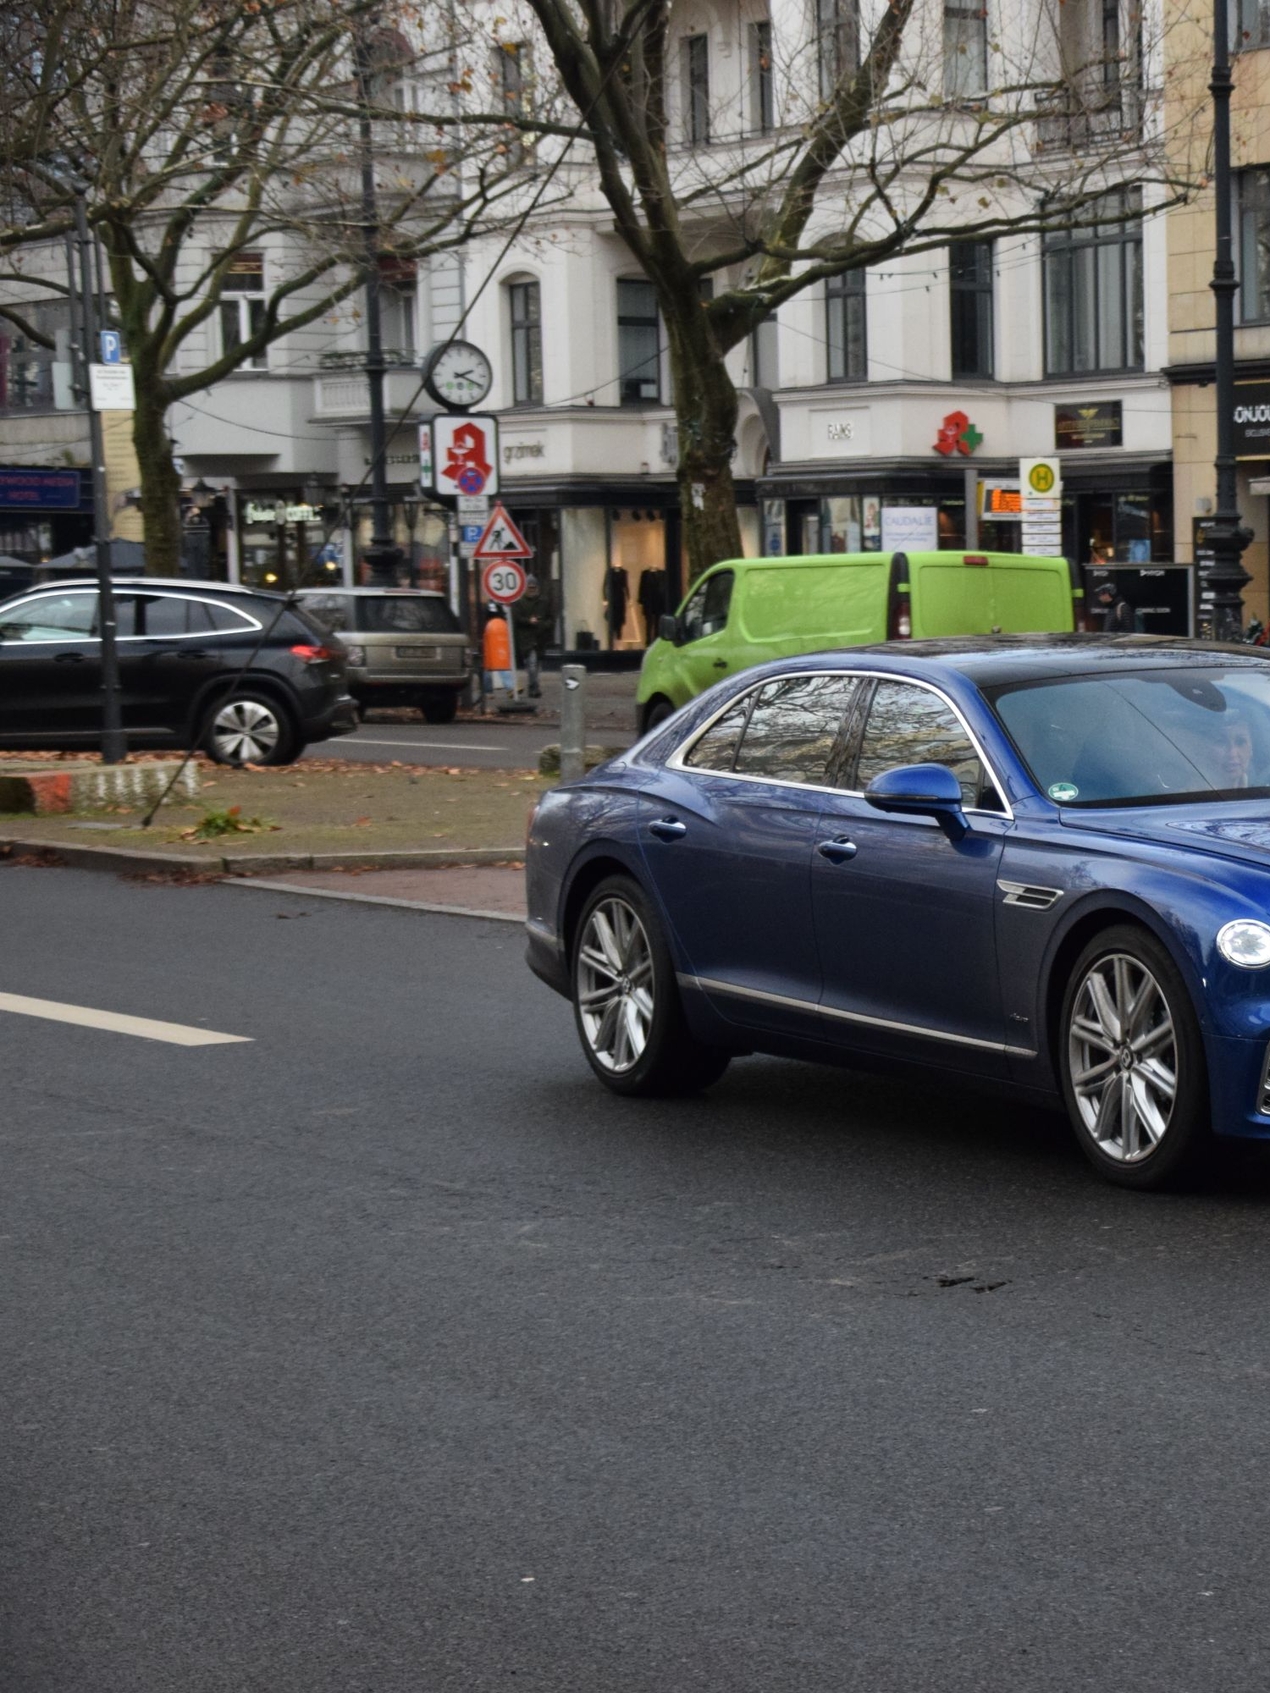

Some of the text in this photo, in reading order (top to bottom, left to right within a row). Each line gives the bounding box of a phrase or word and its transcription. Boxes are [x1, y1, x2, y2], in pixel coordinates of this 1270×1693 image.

[105, 335, 117, 360] P
[827, 423, 853, 441] RAINS
[1035, 471, 1049, 487] H
[492, 572, 518, 592] 30
